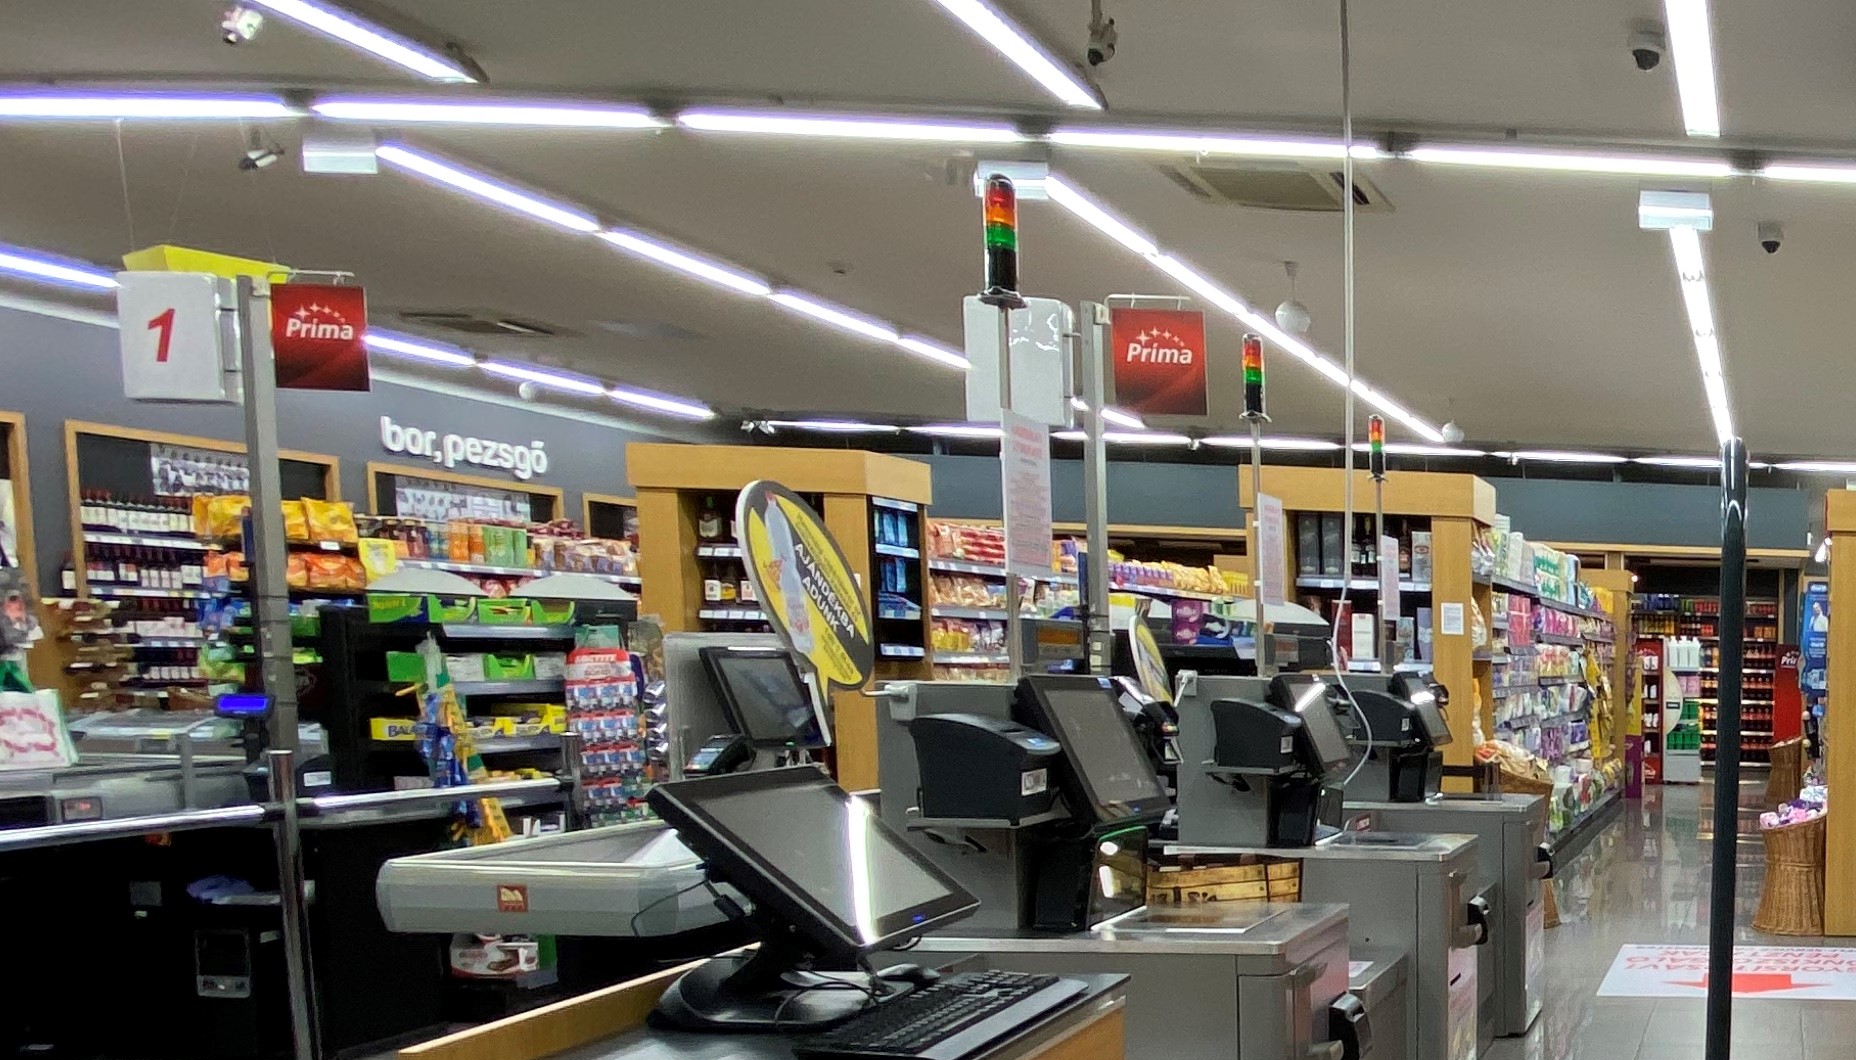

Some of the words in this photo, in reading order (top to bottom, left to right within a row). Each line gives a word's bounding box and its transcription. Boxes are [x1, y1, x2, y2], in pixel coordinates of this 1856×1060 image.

[147, 308, 176, 362] 1
[286, 317, 354, 341] Prima
[1126, 340, 1193, 366] Prima
